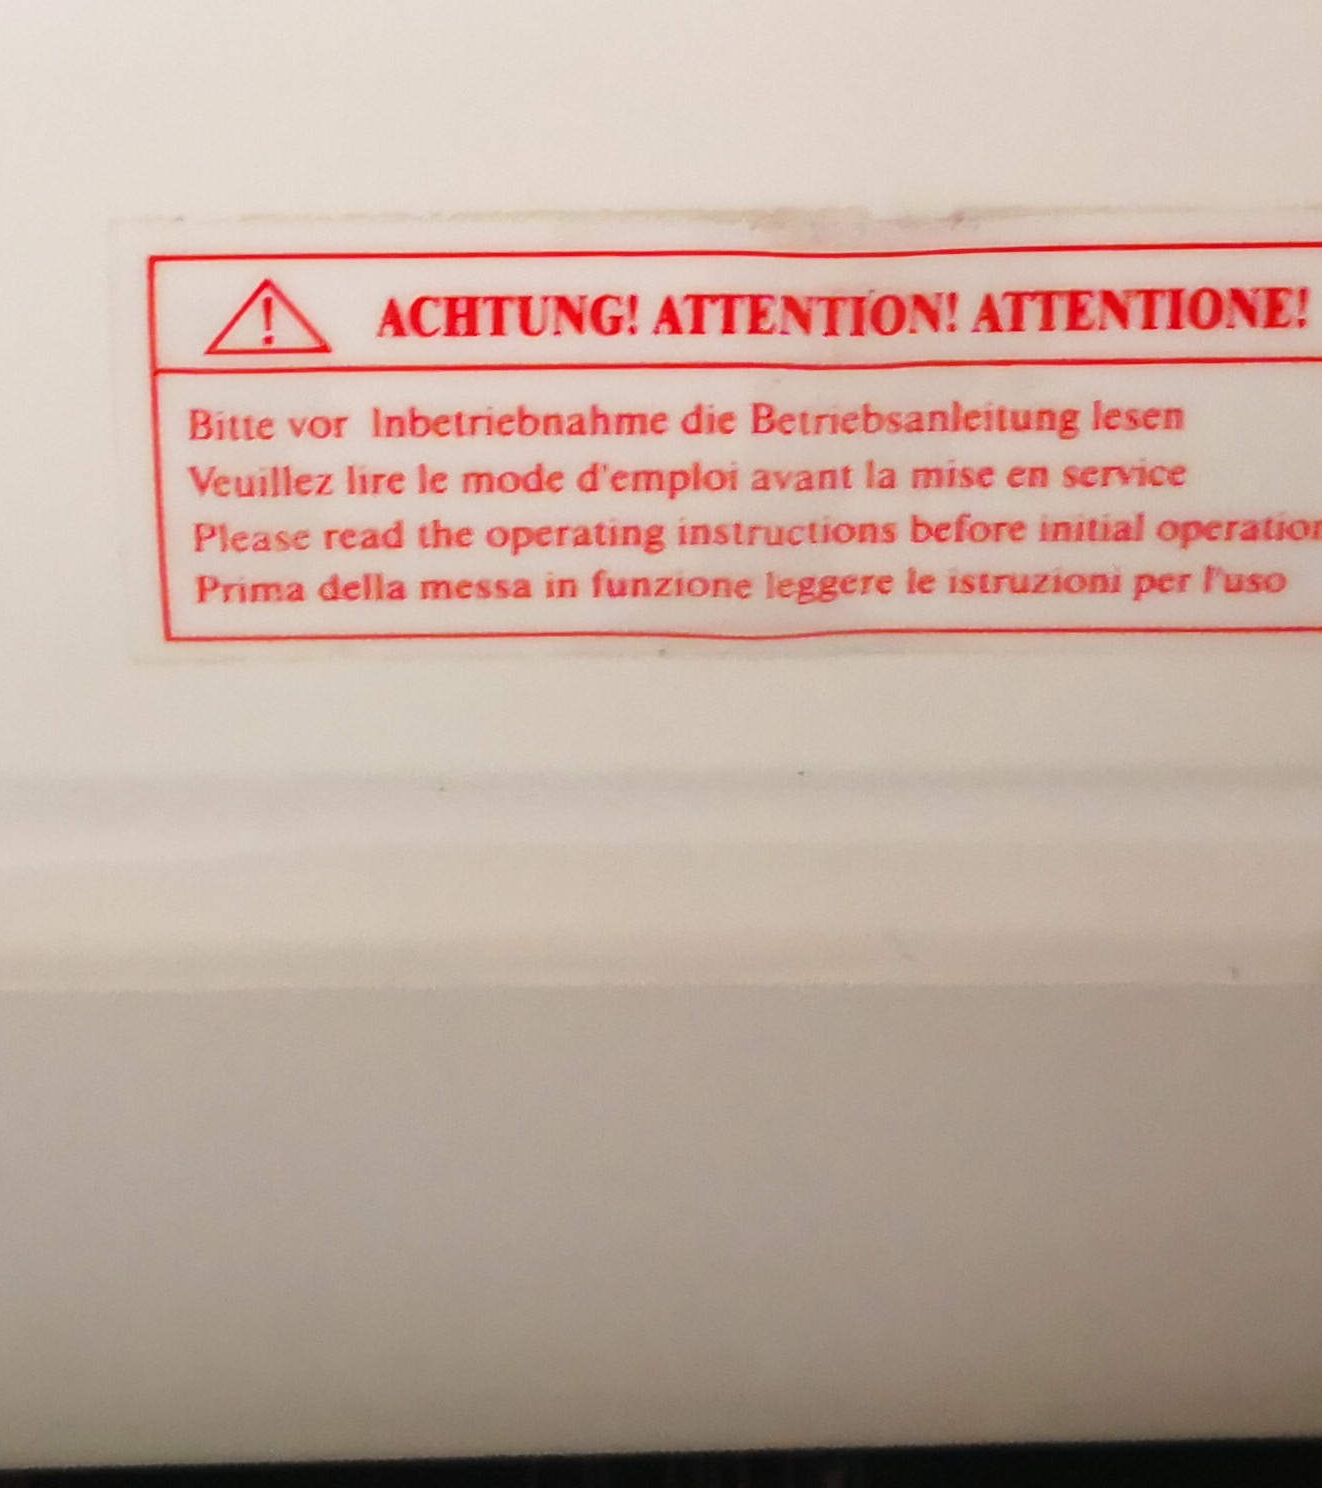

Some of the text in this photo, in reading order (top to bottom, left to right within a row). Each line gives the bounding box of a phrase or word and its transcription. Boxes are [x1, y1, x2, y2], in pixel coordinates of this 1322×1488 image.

[377, 286, 1310, 338] ACHTUNG! ATTENTION! ATTENTIONE!
[188, 399, 1186, 442] Bitte vor Inbetriebnahme die Betriebsanleitung lesen
[188, 459, 1187, 500] Veuillez lire le mode d'emploi avant la mise en service
[193, 521, 310, 553] Please
[324, 519, 404, 551] read
[418, 519, 473, 550] the
[486, 519, 666, 556] operating
[679, 515, 897, 548] instructions
[910, 513, 1026, 545] before
[1039, 512, 1146, 544] initial
[196, 564, 1288, 604] Prima della messa in funzione leggere le istruzioni per l'uso
